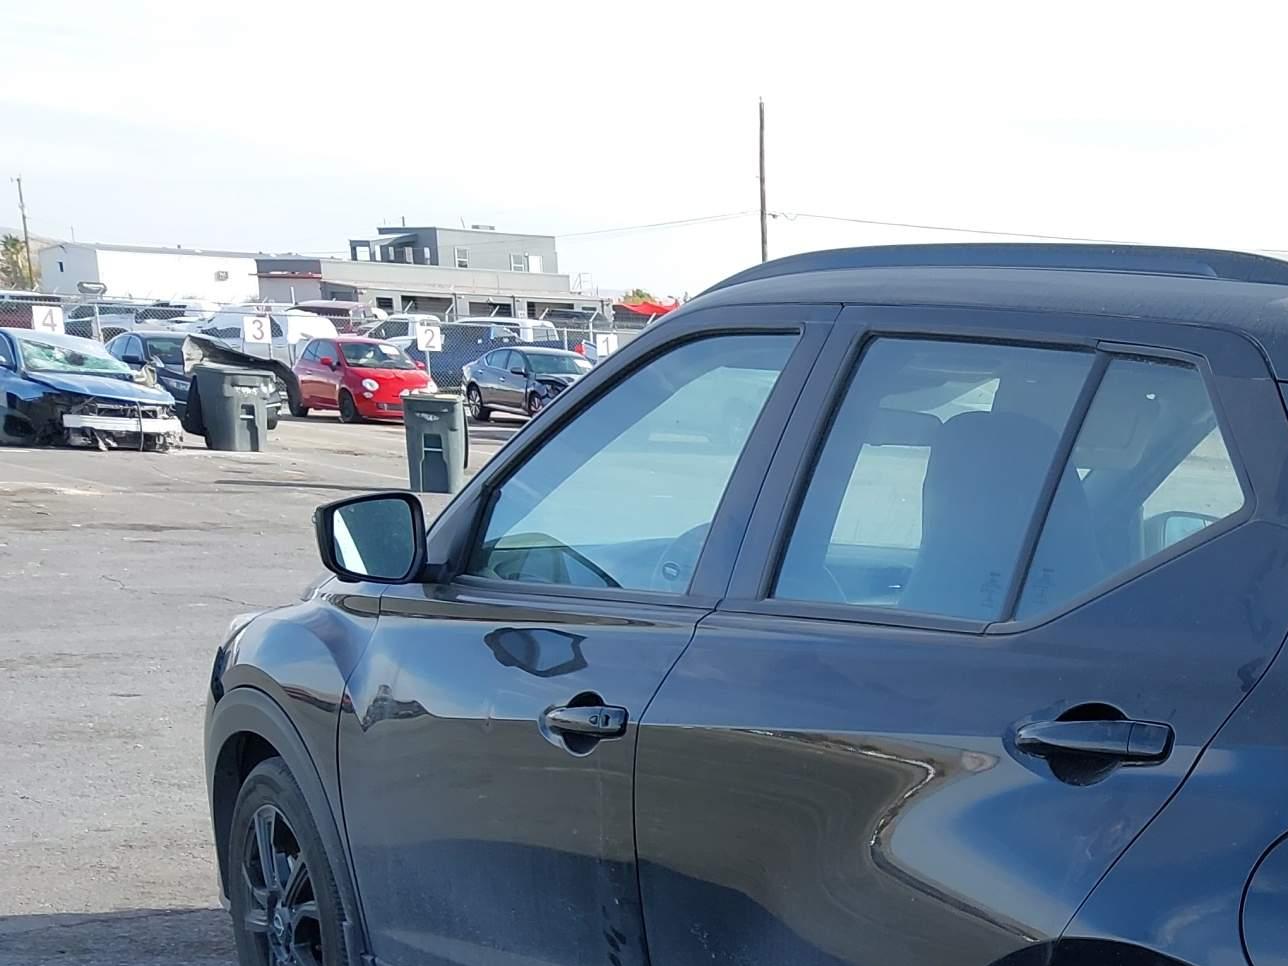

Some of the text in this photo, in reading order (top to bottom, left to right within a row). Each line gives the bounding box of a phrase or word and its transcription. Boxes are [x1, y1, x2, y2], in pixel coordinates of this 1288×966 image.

[41, 308, 57, 332] 4
[252, 319, 265, 341] 3
[424, 328, 436, 349] 2
